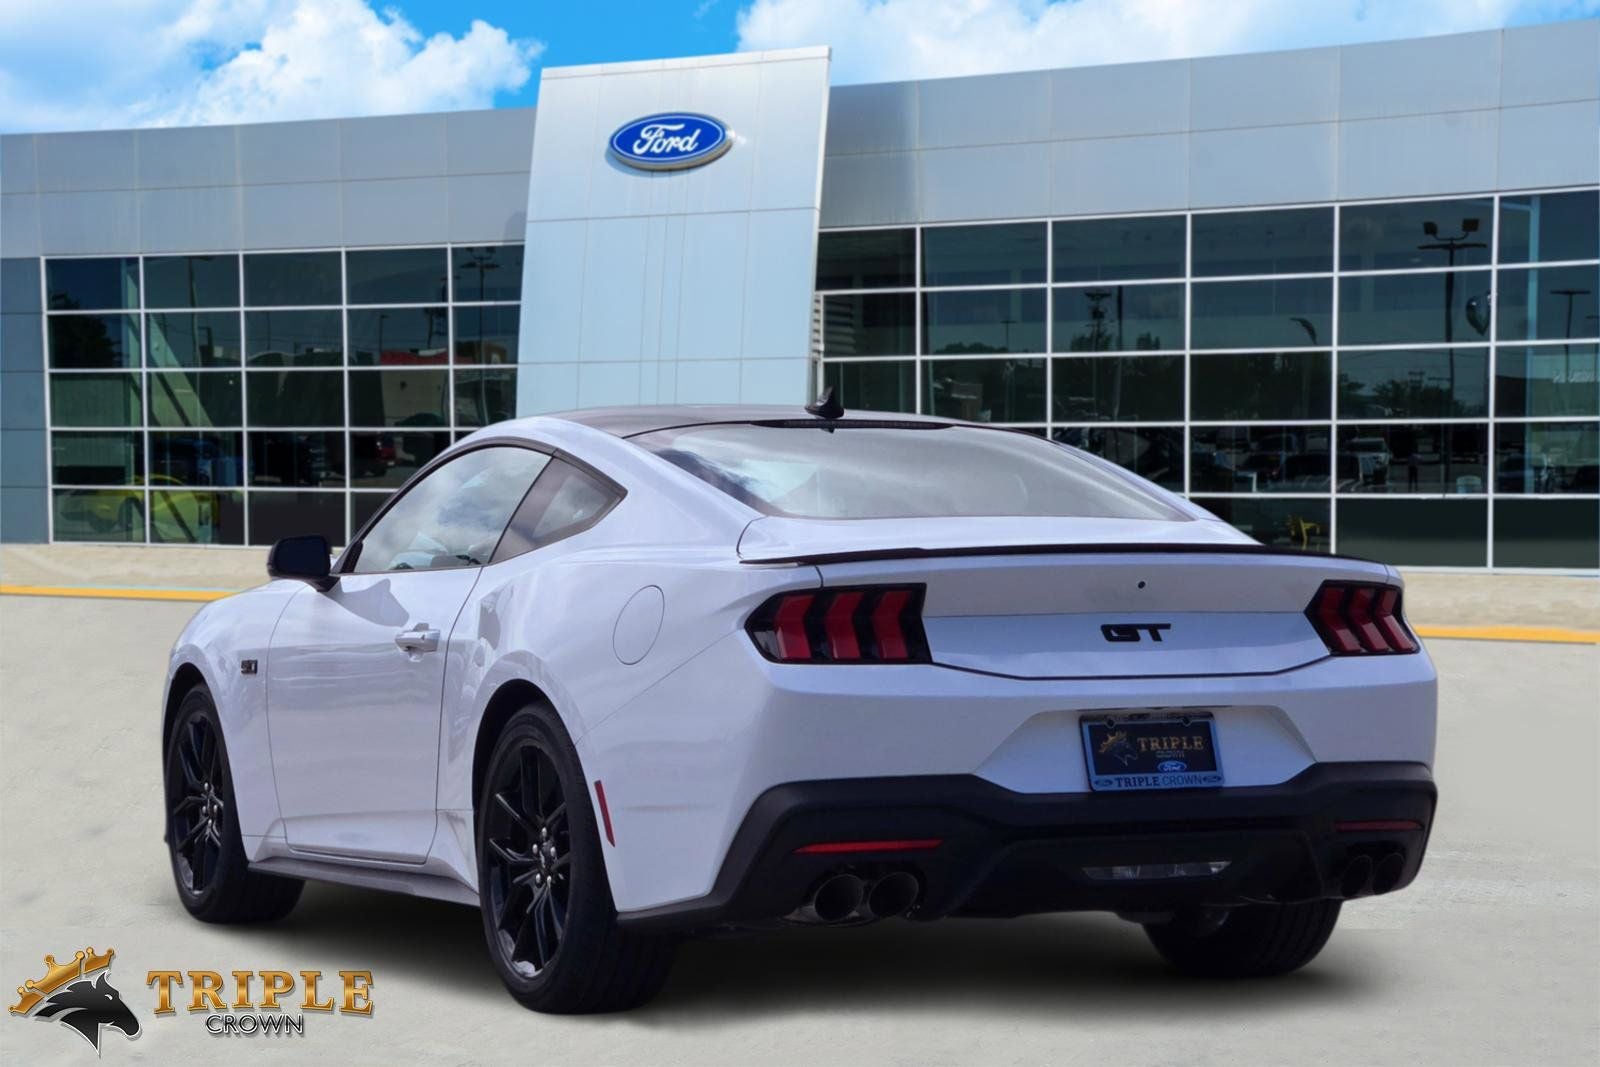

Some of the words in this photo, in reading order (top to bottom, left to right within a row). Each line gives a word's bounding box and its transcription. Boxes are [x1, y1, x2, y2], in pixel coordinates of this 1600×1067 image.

[632, 123, 701, 155] Ford
[1100, 623, 1172, 642] GT
[1137, 736, 1204, 751] TRIPLE
[1115, 776, 1160, 788] TRIPLE
[1161, 774, 1201, 787] CROWN
